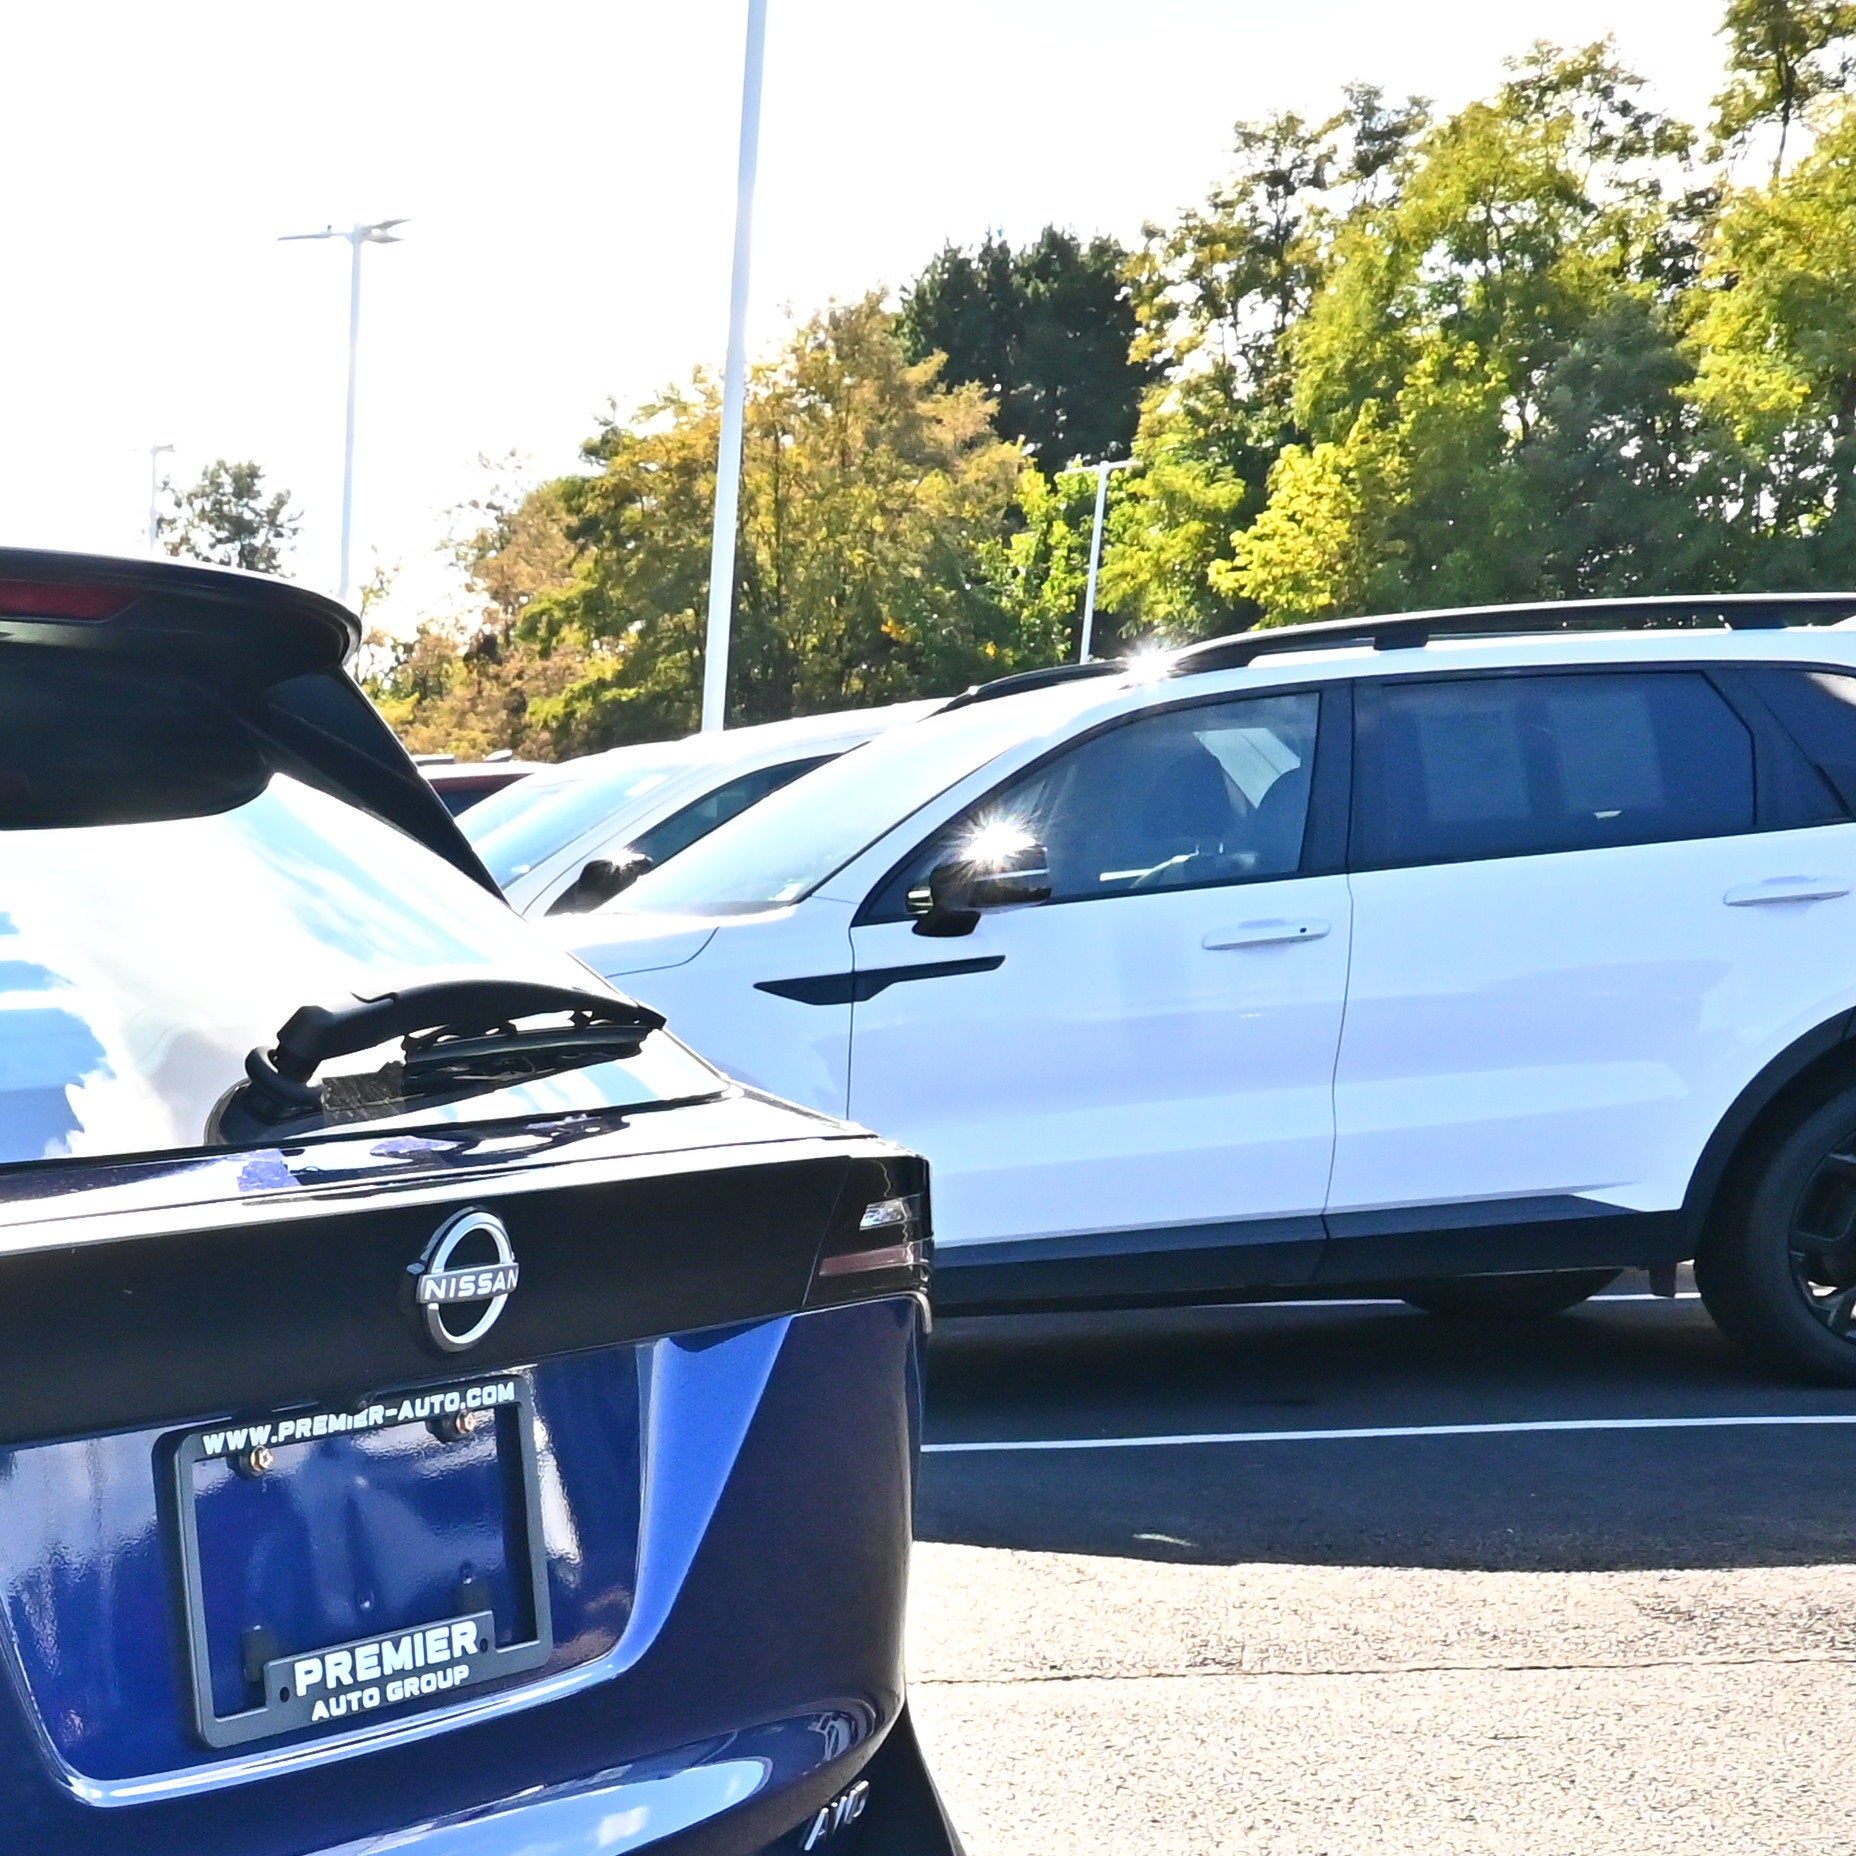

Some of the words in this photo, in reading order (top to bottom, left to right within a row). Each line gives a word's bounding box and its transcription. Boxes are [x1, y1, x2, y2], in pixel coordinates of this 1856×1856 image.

[424, 1268, 519, 1300] NISSAN
[202, 1381, 516, 1456] WWW.PREMIER-AUTO.COM
[294, 1620, 478, 1697] PREMIER
[310, 1684, 380, 1721] AUTO
[386, 1664, 471, 1703] GROUP
